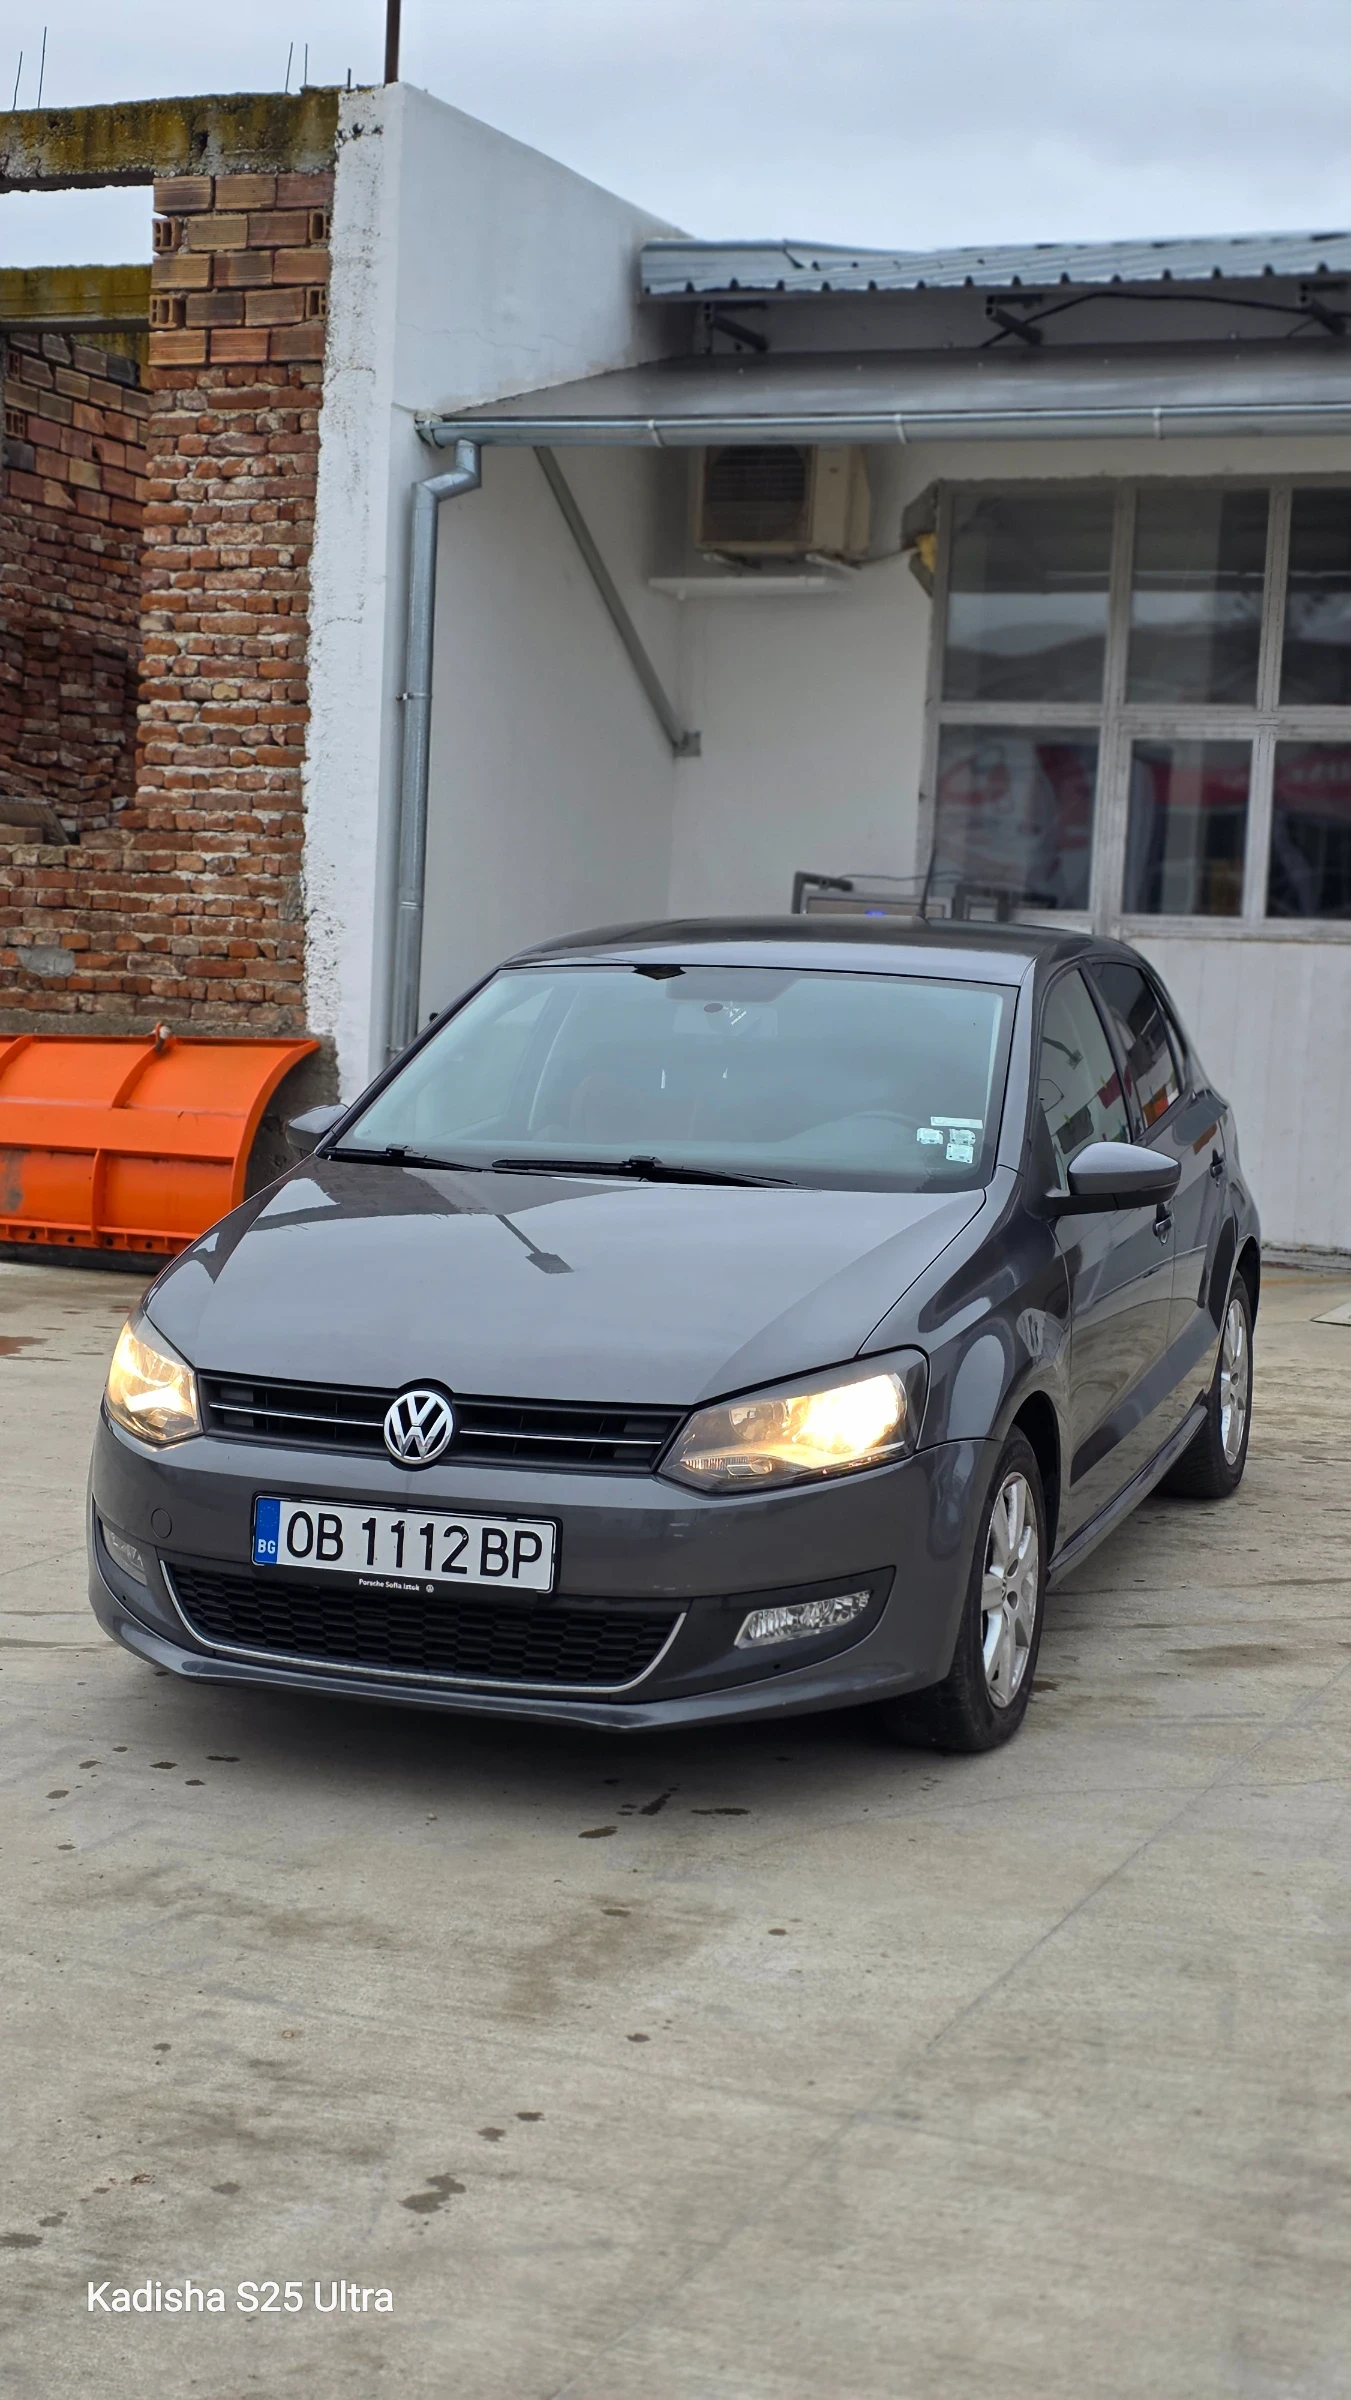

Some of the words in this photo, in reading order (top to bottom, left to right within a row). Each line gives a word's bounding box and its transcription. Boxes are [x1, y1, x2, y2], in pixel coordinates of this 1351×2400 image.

[385, 1391, 453, 1462] VW
[257, 1539, 276, 1554] BG
[286, 1510, 344, 1562] OB
[361, 1517, 470, 1575] 1112
[480, 1527, 543, 1579] BP
[358, 1578, 385, 1588] Porsche
[385, 1581, 402, 1590] Sofia
